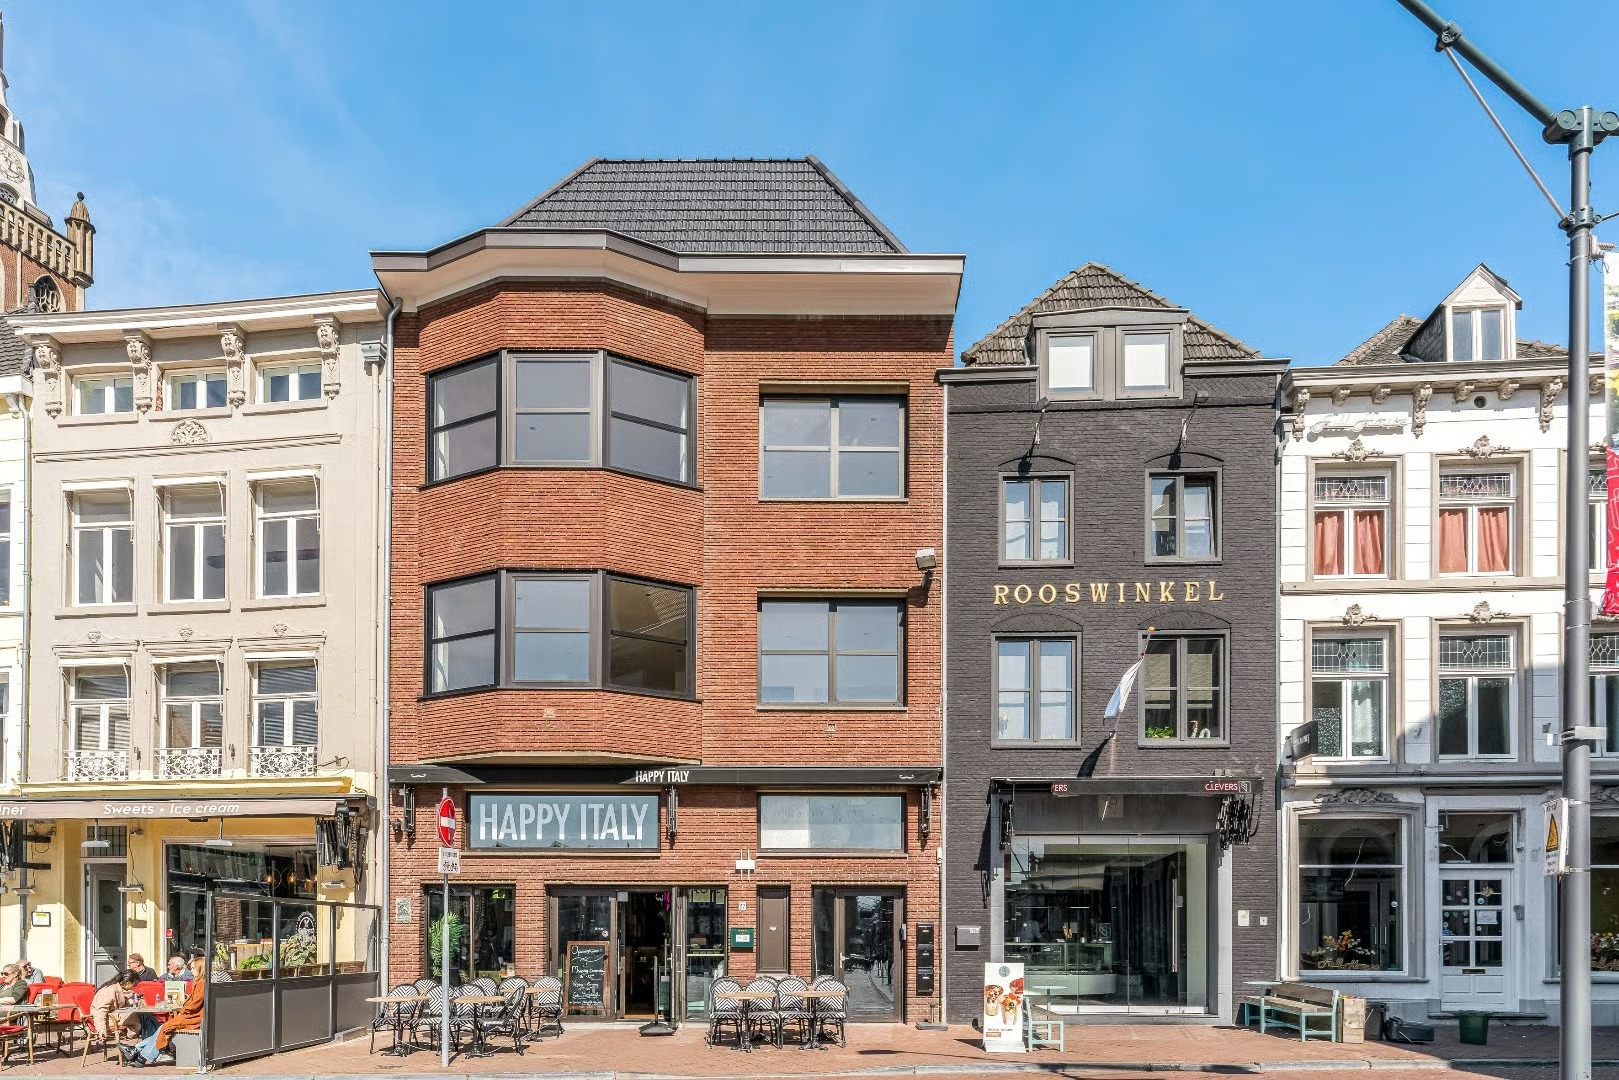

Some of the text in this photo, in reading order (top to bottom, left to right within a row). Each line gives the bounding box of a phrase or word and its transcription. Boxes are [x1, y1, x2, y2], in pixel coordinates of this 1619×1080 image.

[993, 581, 1224, 605] ROOSWINKEL
[635, 770, 690, 783] HAPPY ITALY
[1052, 784, 1068, 792] ERS
[1204, 783, 1238, 791] CLEVERS
[103, 803, 240, 815] Sweets Ice cream
[479, 803, 649, 841] HAPPY ITALY
